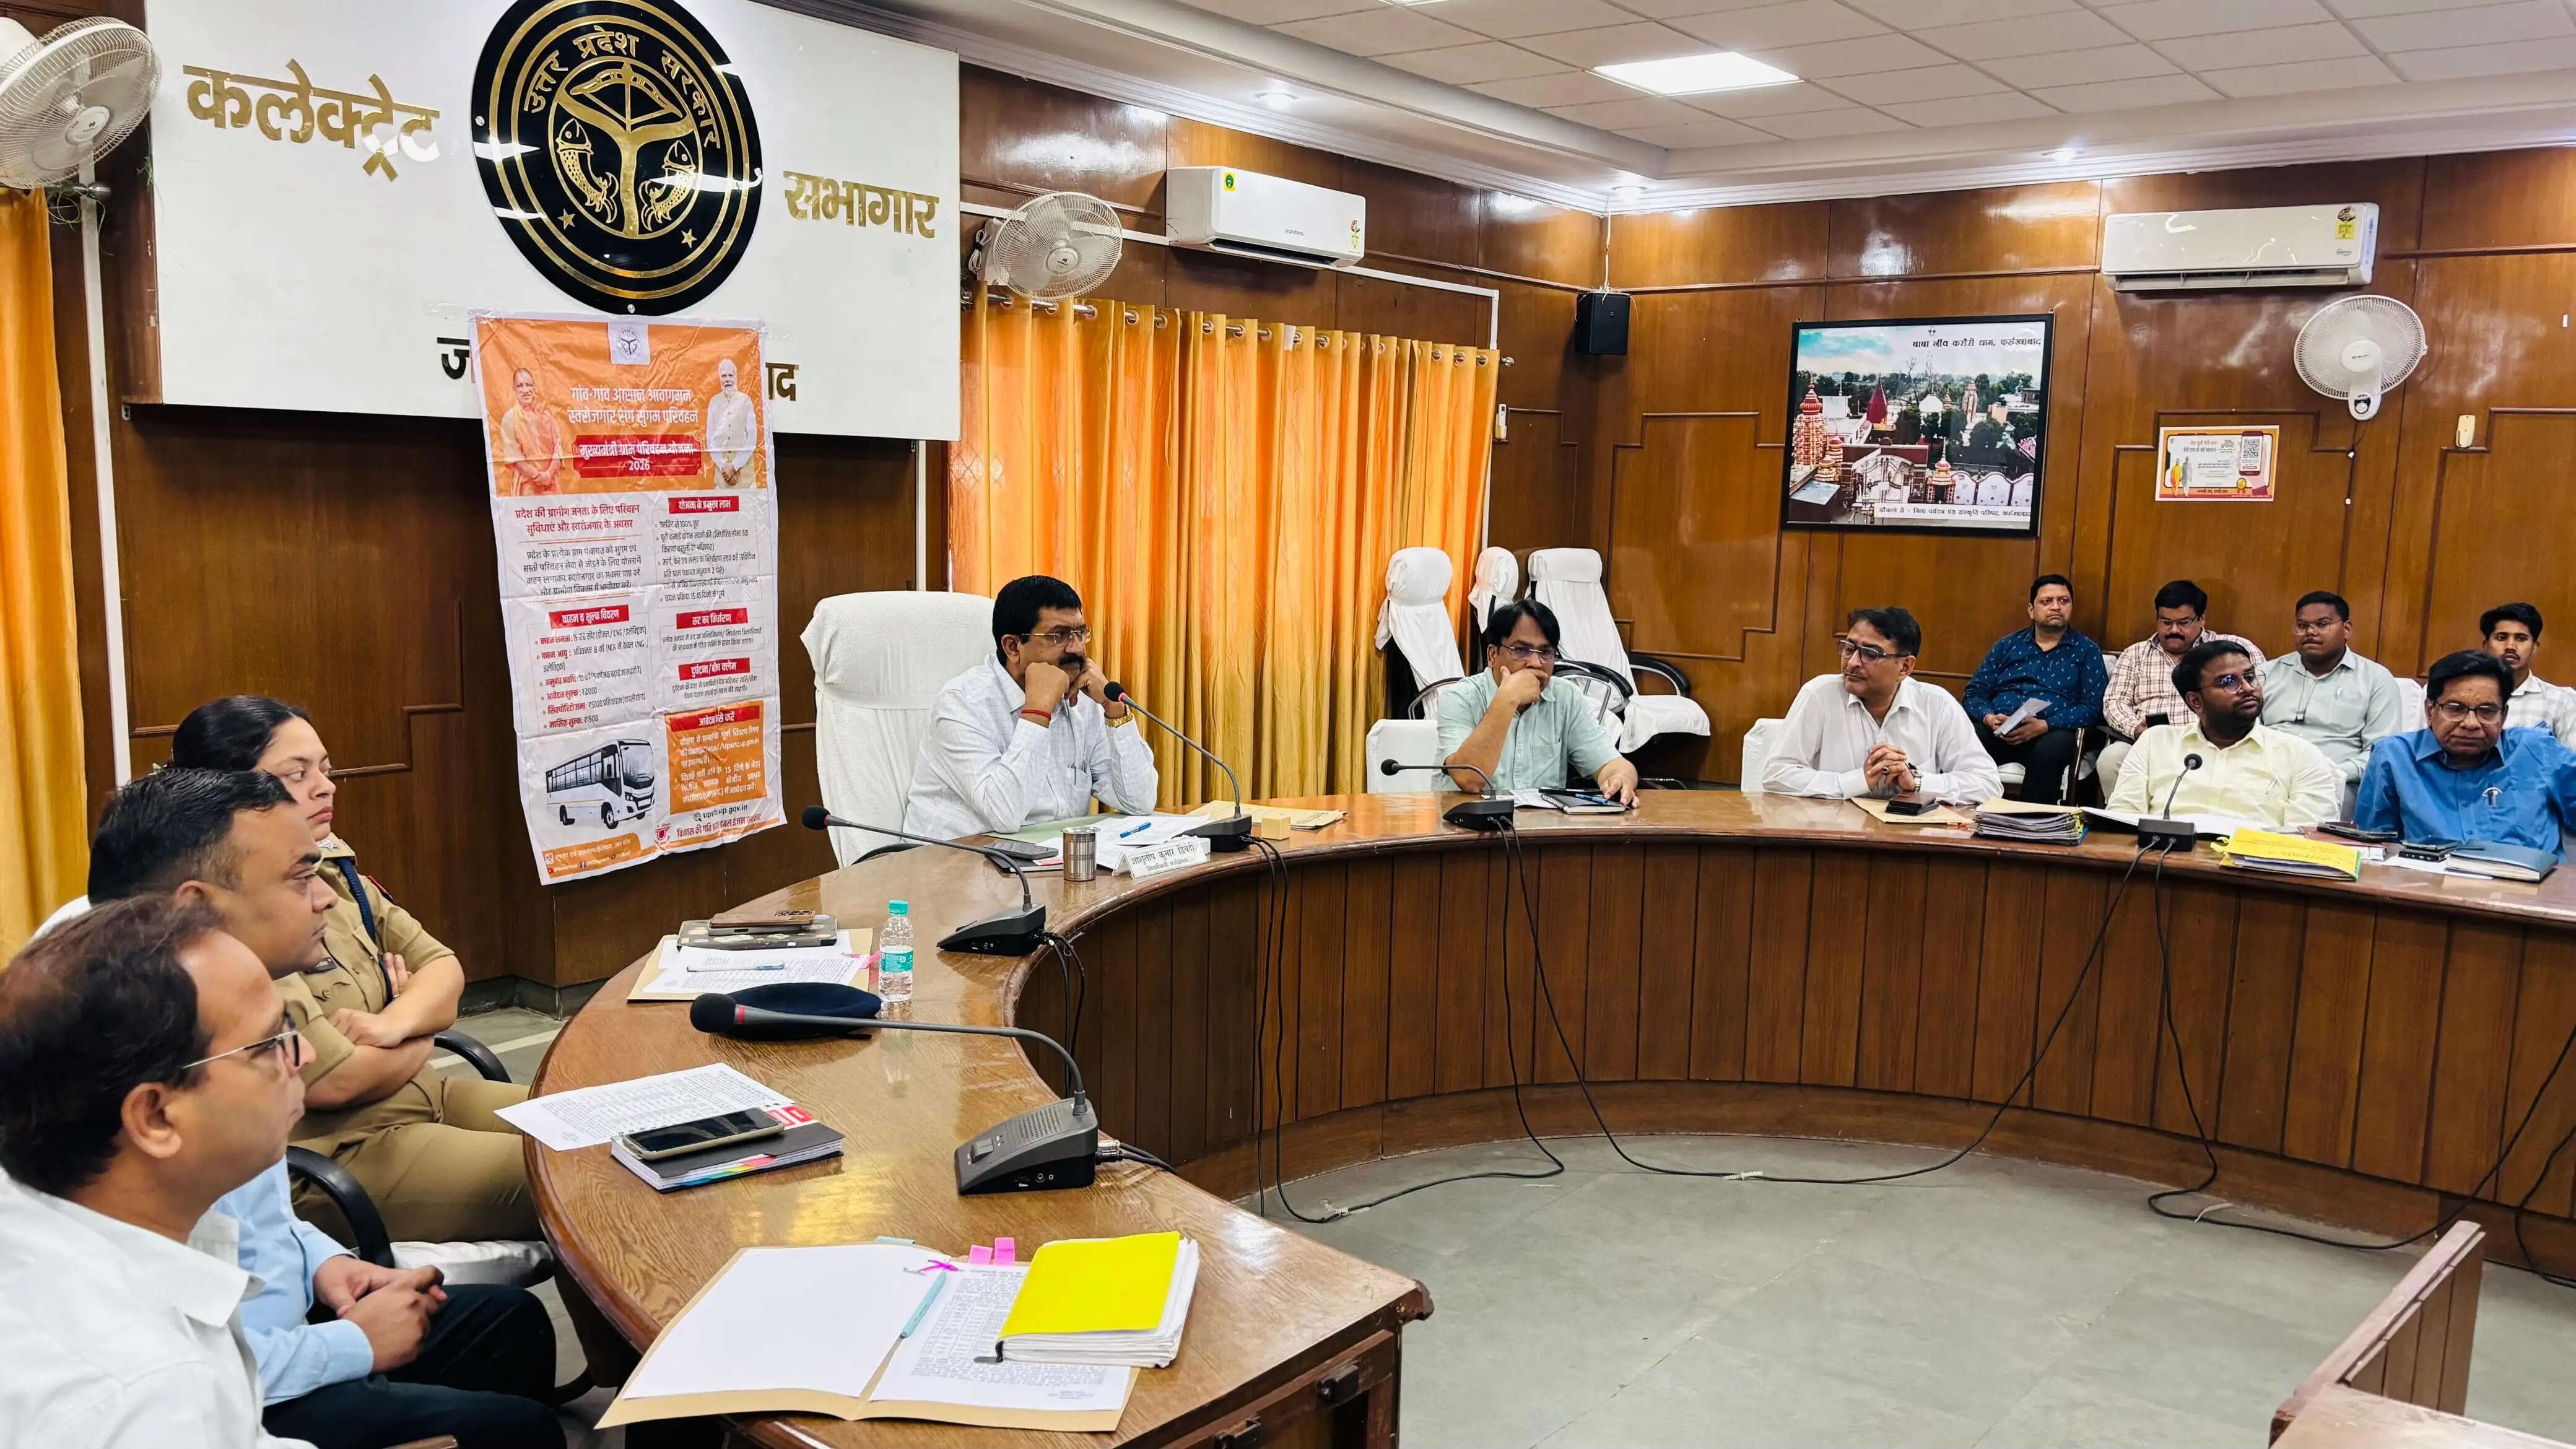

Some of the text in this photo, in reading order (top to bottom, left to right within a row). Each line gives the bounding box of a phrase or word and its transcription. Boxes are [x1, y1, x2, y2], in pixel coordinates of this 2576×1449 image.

[523, 25, 721, 149] उत्तर प्रदेश सरकार
[183, 58, 440, 182] कलेक्ट्रेट
[783, 170, 939, 238] सभागार
[570, 385, 691, 402] गांव-गांव आसान आवागमन
[567, 406, 698, 427] स्वरोजगार संग सुगम परिवहन
[578, 441, 617, 459] मुख्यमंत्री
[618, 444, 635, 456] ग्राम
[636, 441, 666, 455] परिवहन
[629, 460, 650, 471] 2026
[515, 503, 640, 519] प्रदेश की ग्रामीण जनता के लिए परिवहन
[678, 498, 697, 510] योजना
[557, 520, 570, 532] और
[572, 521, 602, 531] स्वरोजगार
[603, 519, 612, 529] के
[613, 520, 633, 529] अवसर
[527, 550, 541, 559] प्रदेश
[542, 549, 549, 558] के
[552, 547, 570, 557] प्रत्येक
[572, 549, 583, 557] ग्राम
[614, 546, 627, 556] सुगम
[523, 562, 537, 573] सस्ती
[539, 561, 564, 571] परिवहन
[578, 559, 583, 568] से
[601, 558, 607, 566] के
[608, 557, 620, 566] लिए
[526, 577, 541, 585] वाहन
[543, 575, 566, 583] लगाकर
[562, 613, 578, 624] वाहन
[601, 608, 619, 620] विवरण
[557, 650, 568, 660] आयु
[547, 690, 565, 700] आवेदन
[1131, 851, 1155, 865] आशुतोष
[1159, 848, 1175, 861] कुमार
